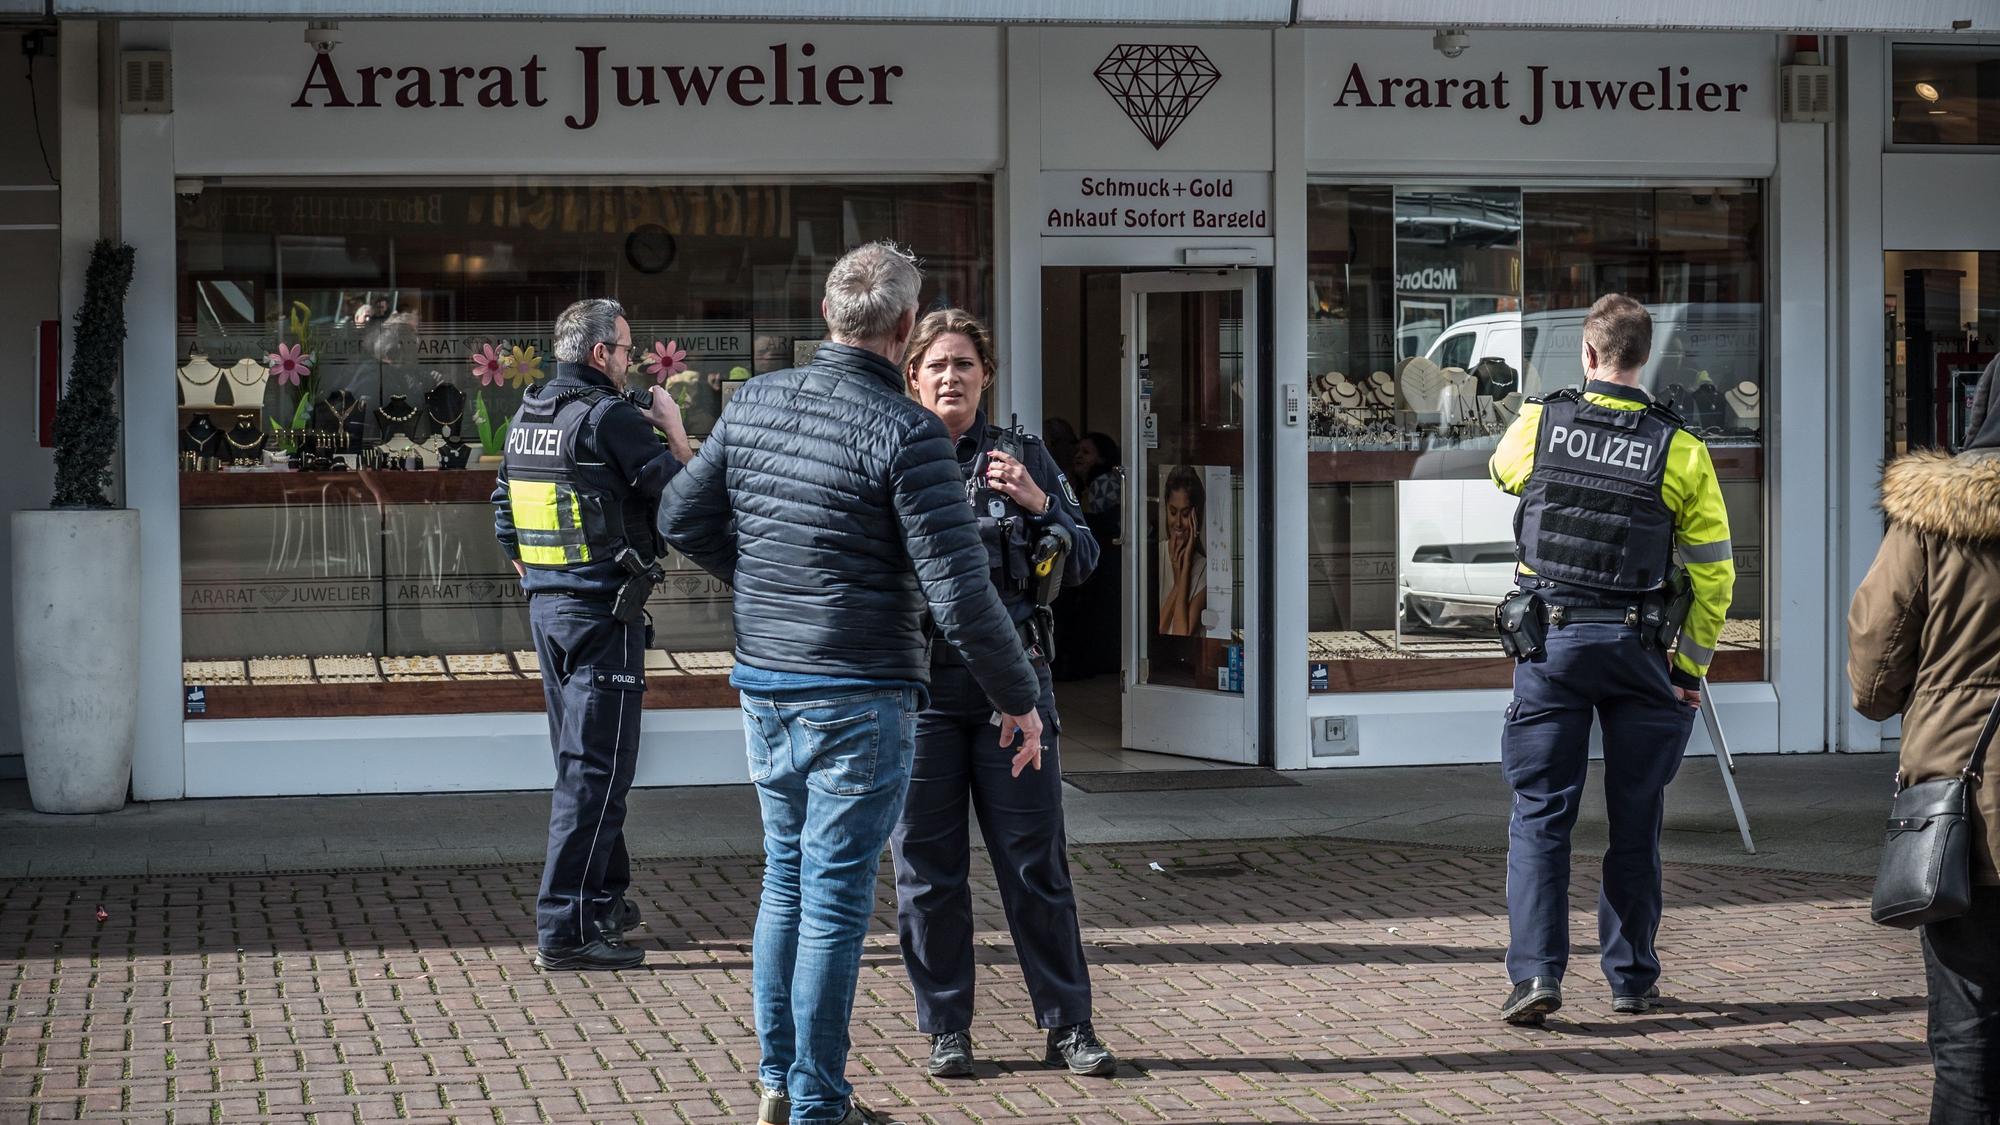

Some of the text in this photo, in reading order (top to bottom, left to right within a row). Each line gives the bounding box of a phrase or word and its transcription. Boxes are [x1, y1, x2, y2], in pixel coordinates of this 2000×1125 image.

[291, 42, 904, 130] Ararat Juwelier
[1333, 62, 1749, 126] Ararat Juwelier
[1047, 208, 1267, 229] Ankauf Sofort Bargeld
[507, 428, 563, 456] POLIZEI
[1548, 426, 1653, 471] POLIZEI
[191, 584, 460, 604] ARARAT JUWELIER ARARAT
[612, 673, 636, 685] POLIZEI
